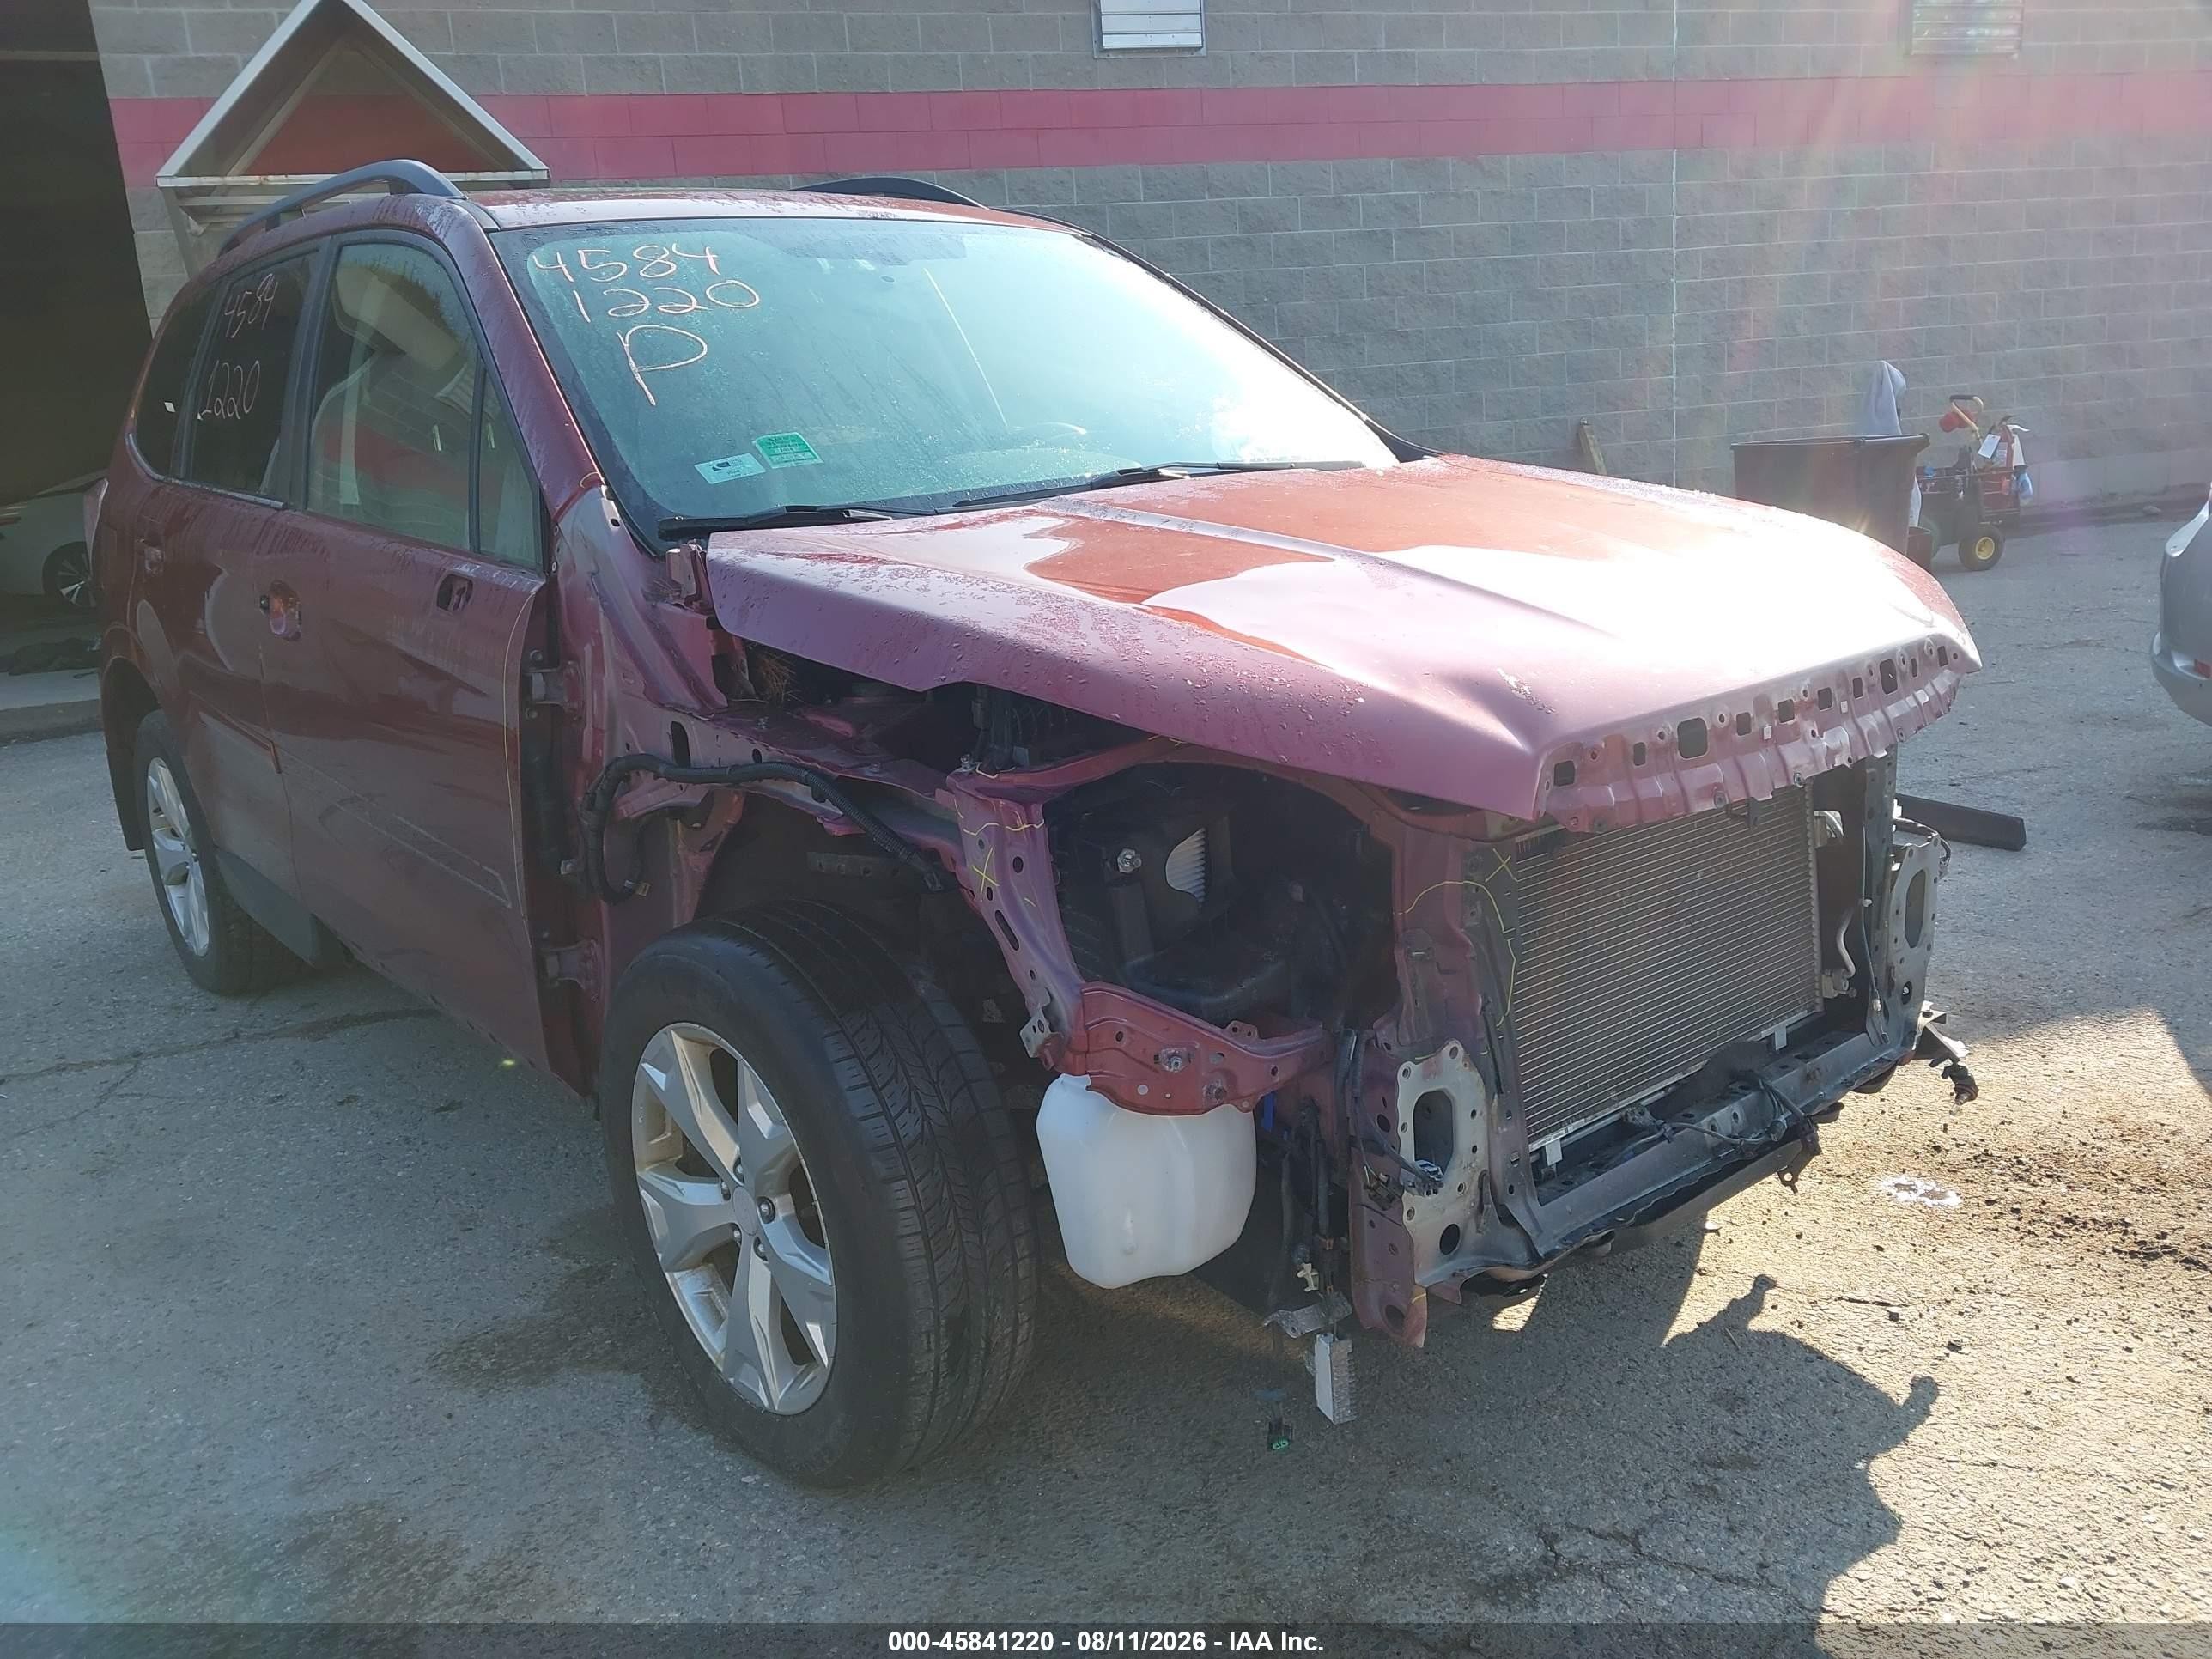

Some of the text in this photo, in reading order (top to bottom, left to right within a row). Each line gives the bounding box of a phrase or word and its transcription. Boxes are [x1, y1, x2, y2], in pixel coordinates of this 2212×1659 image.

[532, 242, 720, 283] 4584
[223, 273, 279, 338] 4584
[572, 279, 761, 324] 1220
[200, 360, 261, 420] 1220
[616, 324, 708, 406] P
